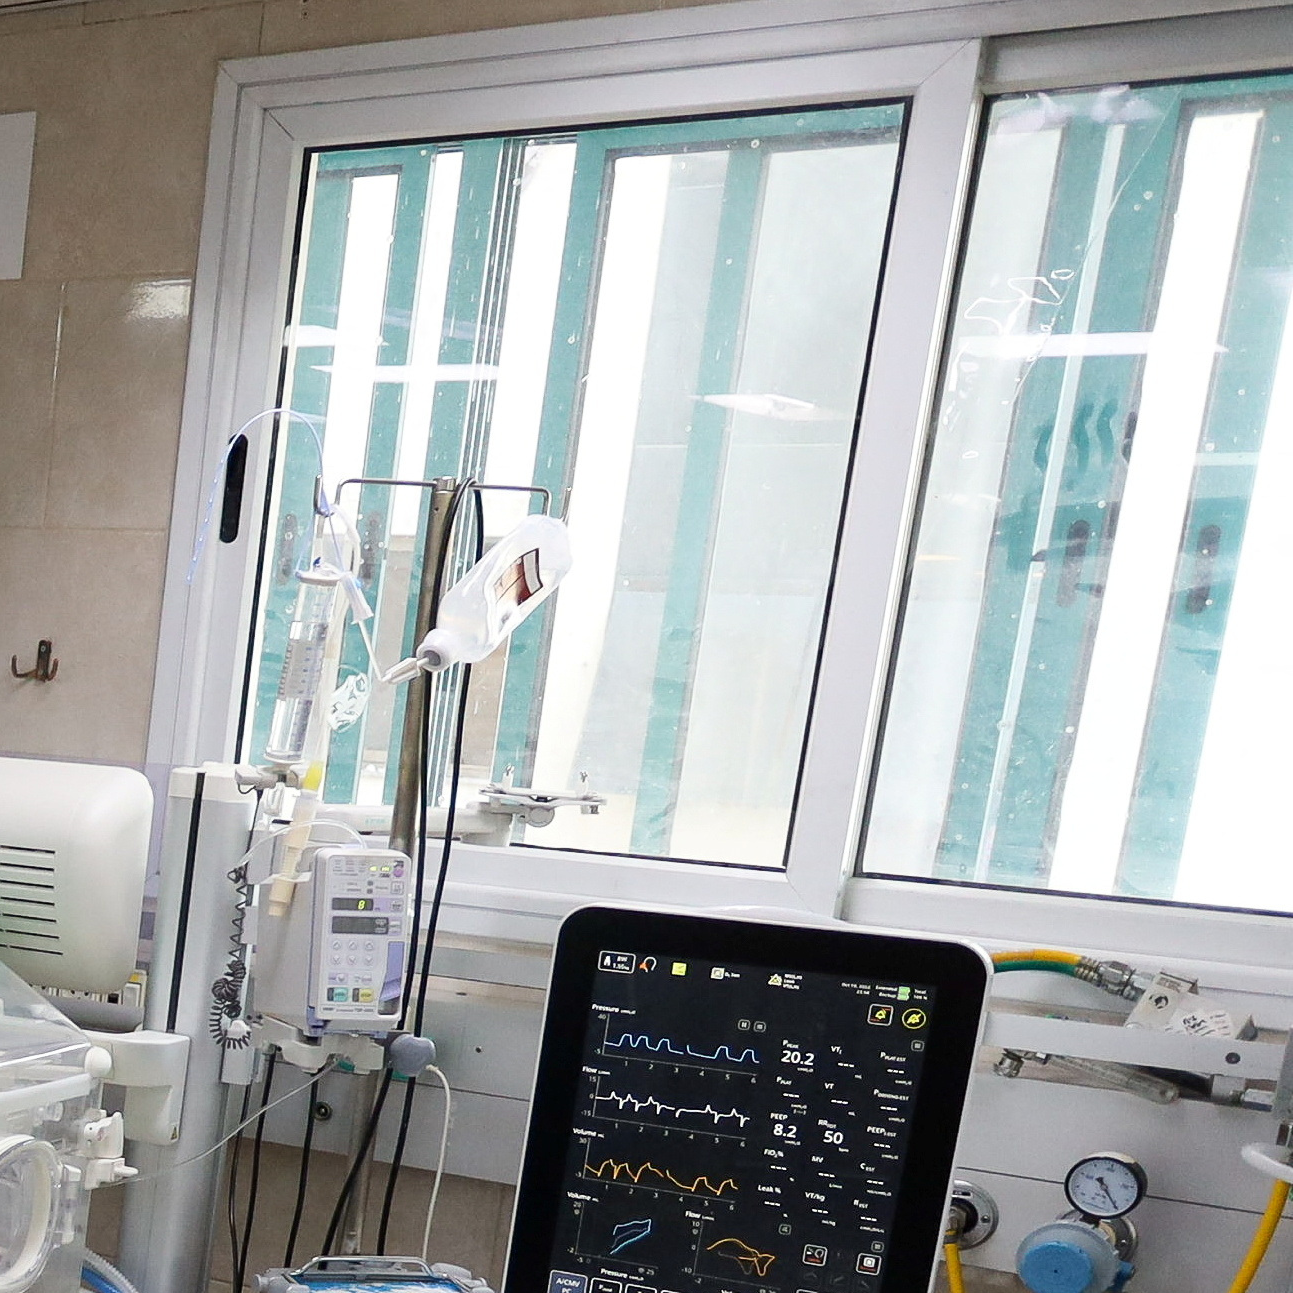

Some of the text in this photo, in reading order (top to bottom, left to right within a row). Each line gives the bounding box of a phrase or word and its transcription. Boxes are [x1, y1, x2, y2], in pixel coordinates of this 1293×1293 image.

[357, 900, 366, 910] 8
[592, 1004, 619, 1013] Pressure
[781, 1050, 815, 1066] 20.2
[582, 1066, 597, 1074] Flow
[770, 1112, 788, 1121] PEEP
[572, 1127, 597, 1137] Volume
[773, 1123, 797, 1138] 8.2
[823, 1130, 844, 1145] 50
[567, 1191, 591, 1201] Volume
[685, 1210, 701, 1219] Flow
[600, 1268, 628, 1280] Pressure
